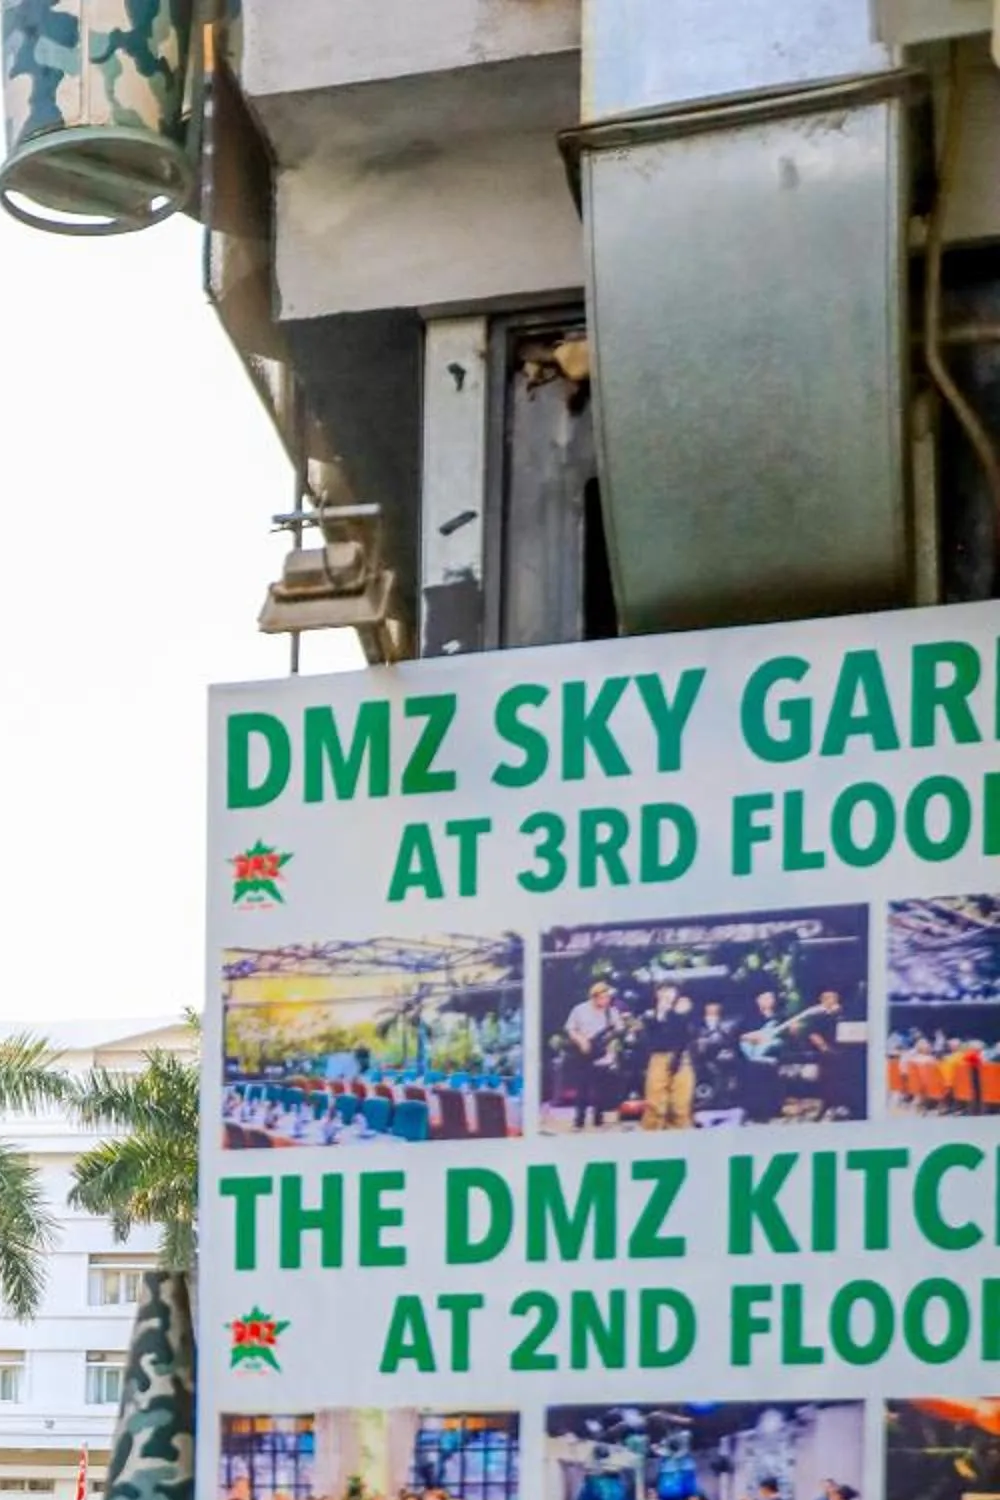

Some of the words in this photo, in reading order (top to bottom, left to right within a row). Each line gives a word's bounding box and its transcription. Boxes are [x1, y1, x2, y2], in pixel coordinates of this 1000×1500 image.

[228, 695, 456, 808] DMZ
[493, 669, 705, 787] SKY
[741, 637, 1000, 762] GAR
[389, 818, 490, 900] AT
[519, 804, 696, 892] 3RD
[733, 773, 1000, 875] FLOO
[220, 1172, 405, 1270] THE
[447, 1159, 686, 1264] DMZ
[729, 1143, 1000, 1254] KITC
[381, 1294, 482, 1372] AT
[512, 1289, 696, 1370] 2ND
[732, 1278, 1000, 1365] FLOO
